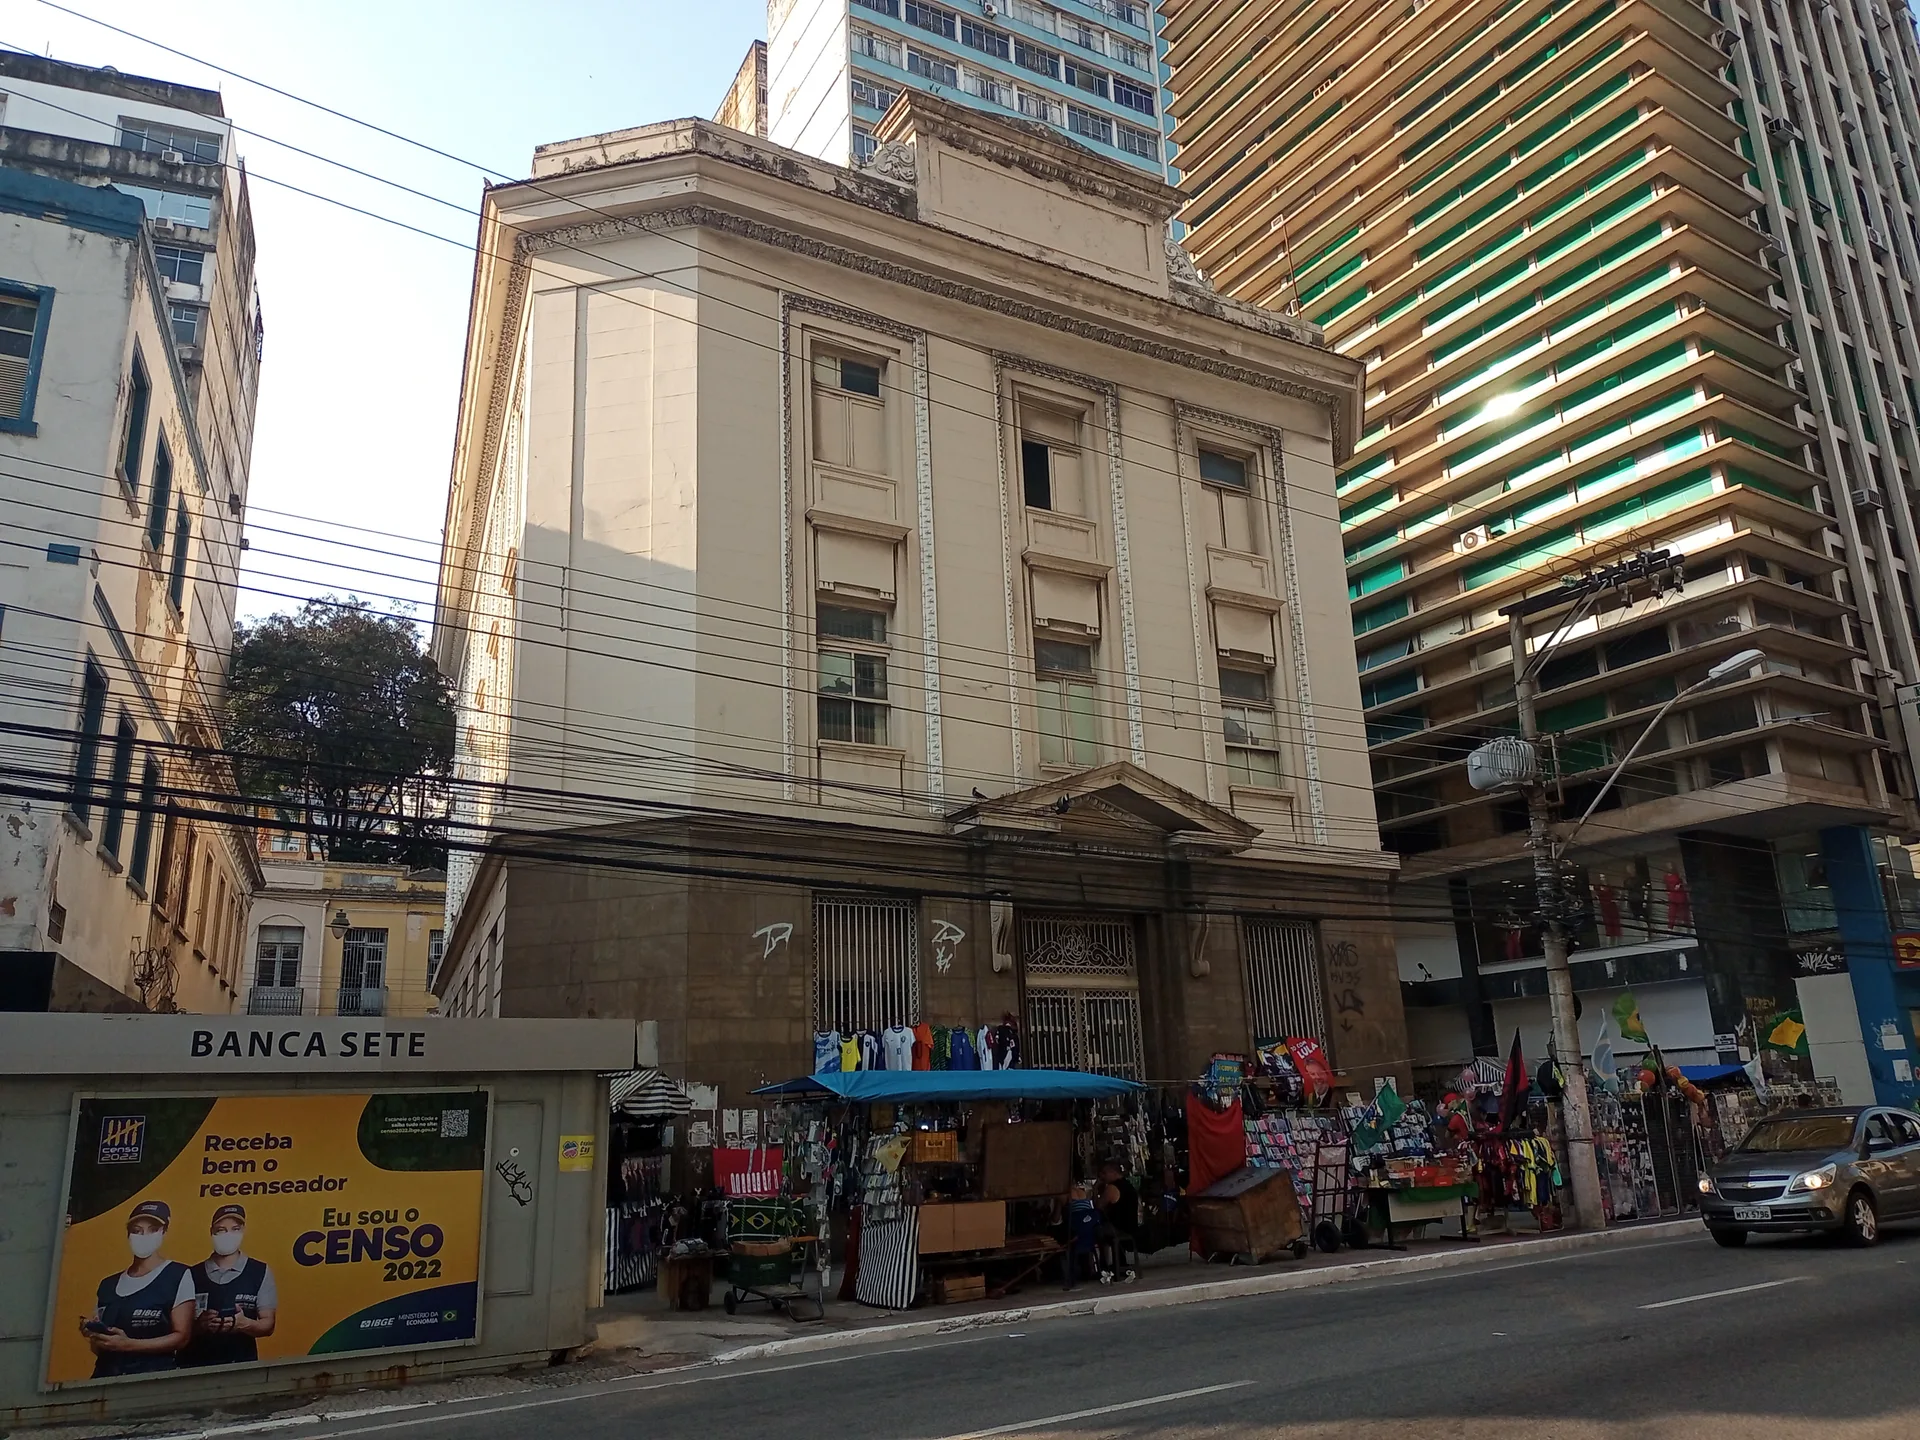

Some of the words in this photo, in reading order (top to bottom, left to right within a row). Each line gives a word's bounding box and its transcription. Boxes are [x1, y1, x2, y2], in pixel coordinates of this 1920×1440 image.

[190, 1030, 327, 1057] BANCA
[339, 1031, 426, 1057] SETE
[1296, 1041, 1319, 1060] LULA
[102, 1146, 139, 1154] censo
[204, 1133, 292, 1152] Receba
[101, 1153, 138, 1161] 2022
[202, 1157, 256, 1174] bem
[263, 1158, 278, 1172] o
[199, 1175, 348, 1198] recenseador
[323, 1208, 350, 1227] Eu
[357, 1210, 398, 1225] sou
[405, 1208, 419, 1222] o
[1751, 1210, 1769, 1219] 5796
[292, 1223, 444, 1266] CENSO
[383, 1259, 442, 1282] 2022
[141, 1309, 162, 1317] IBGE
[371, 1317, 395, 1327] IBGE
[406, 1318, 438, 1326] ECONOMIA
